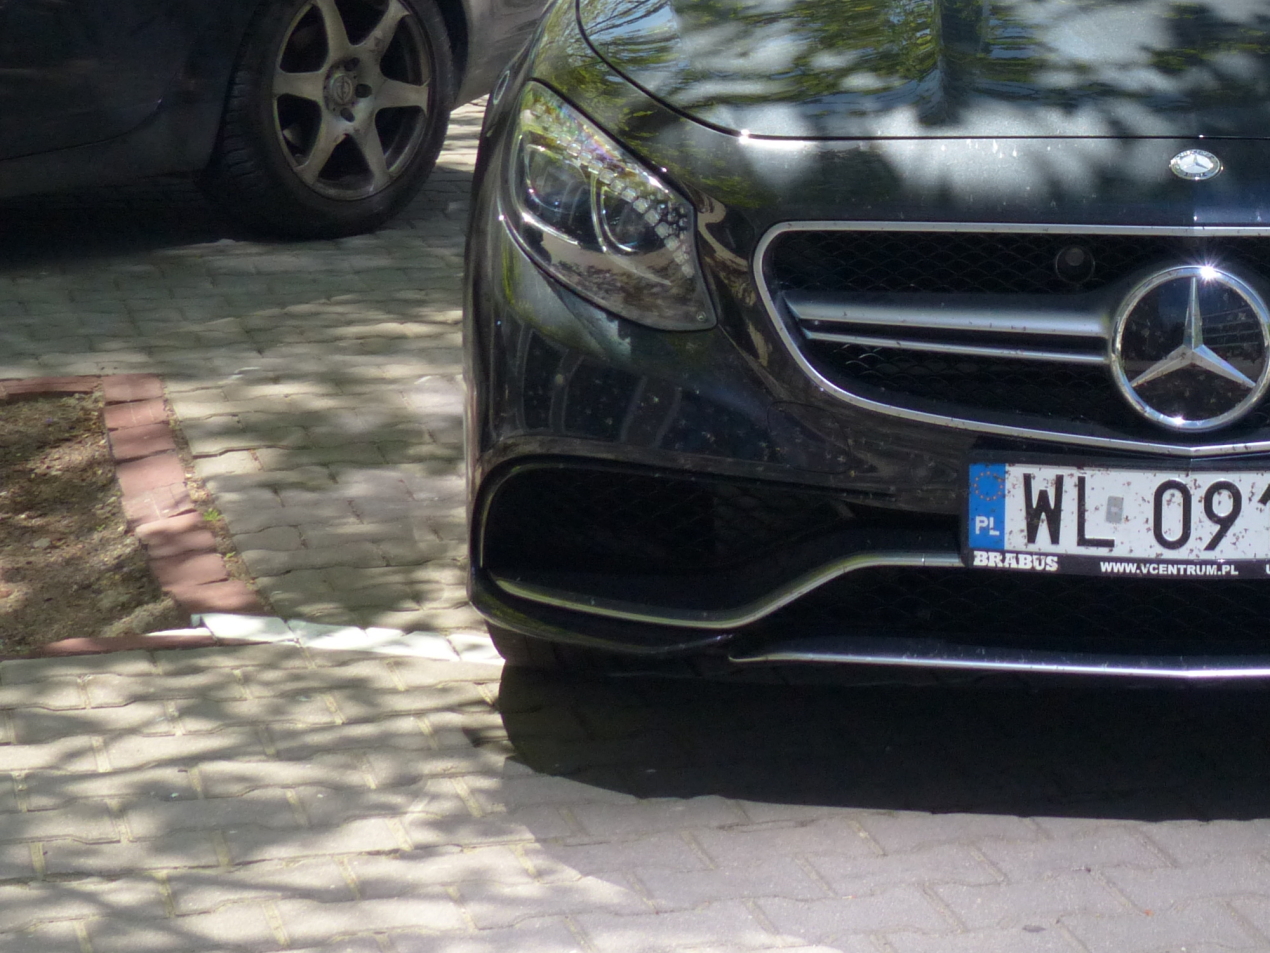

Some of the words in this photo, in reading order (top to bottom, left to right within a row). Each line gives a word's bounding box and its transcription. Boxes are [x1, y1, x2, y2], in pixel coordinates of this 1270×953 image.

[1023, 472, 1116, 548] WL
[975, 515, 1000, 537] PL
[973, 550, 1059, 571] BRABUS
[1100, 560, 1239, 576] WWW.VCENTRUM.PL
